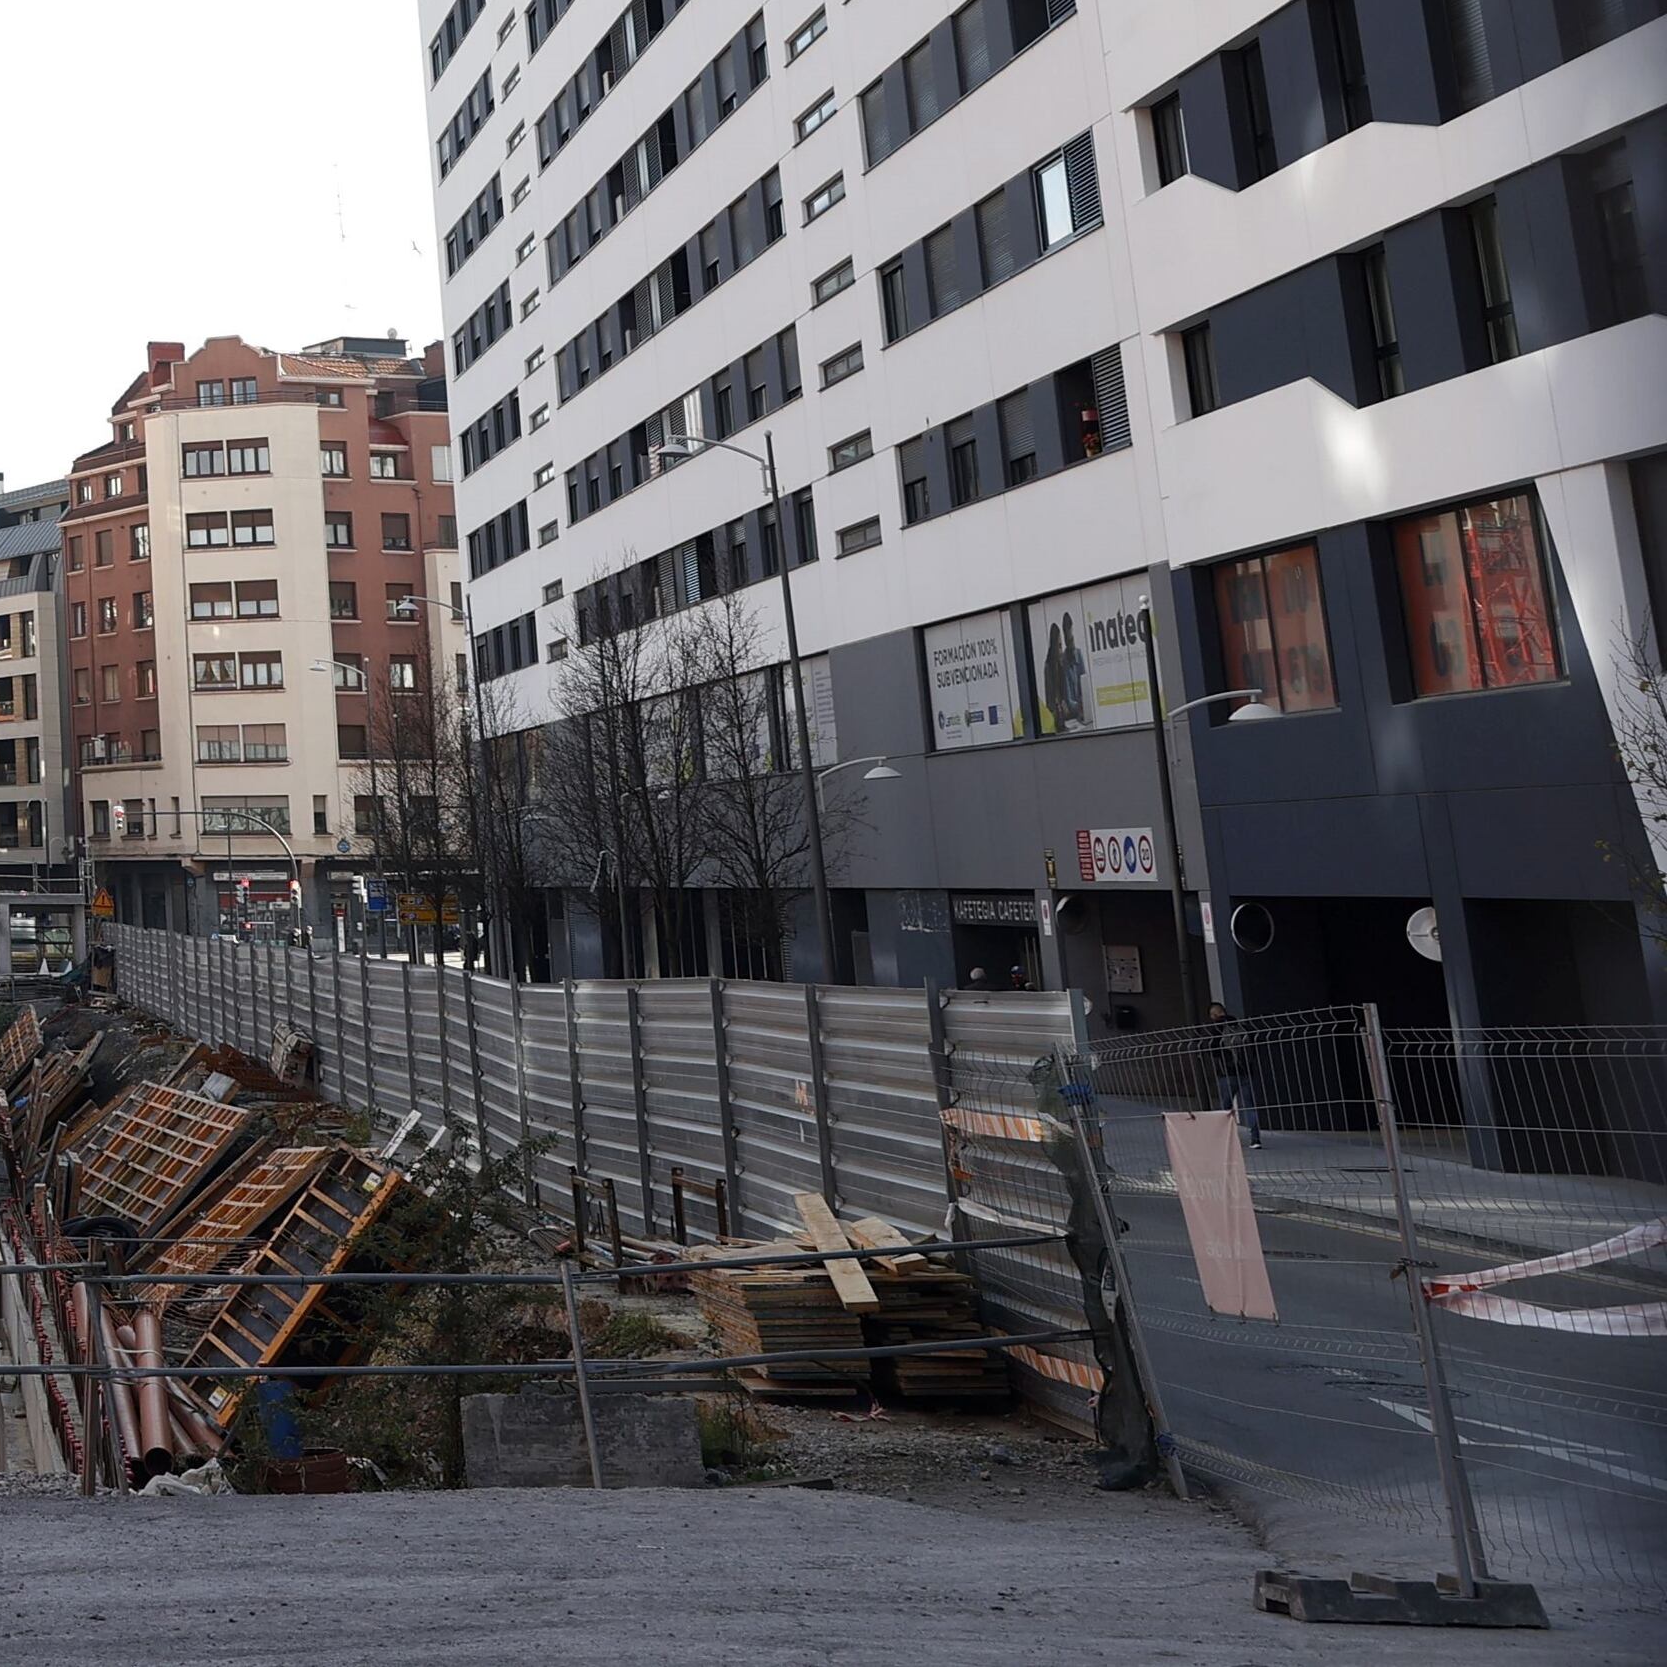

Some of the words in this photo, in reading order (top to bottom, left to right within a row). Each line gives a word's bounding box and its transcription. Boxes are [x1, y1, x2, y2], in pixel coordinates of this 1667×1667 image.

[933, 639, 977, 667] FORMACIÓN
[977, 638, 998, 658] 100%
[937, 661, 1000, 689] SUBVENCIONADA
[953, 900, 996, 920] KAFETEGIA
